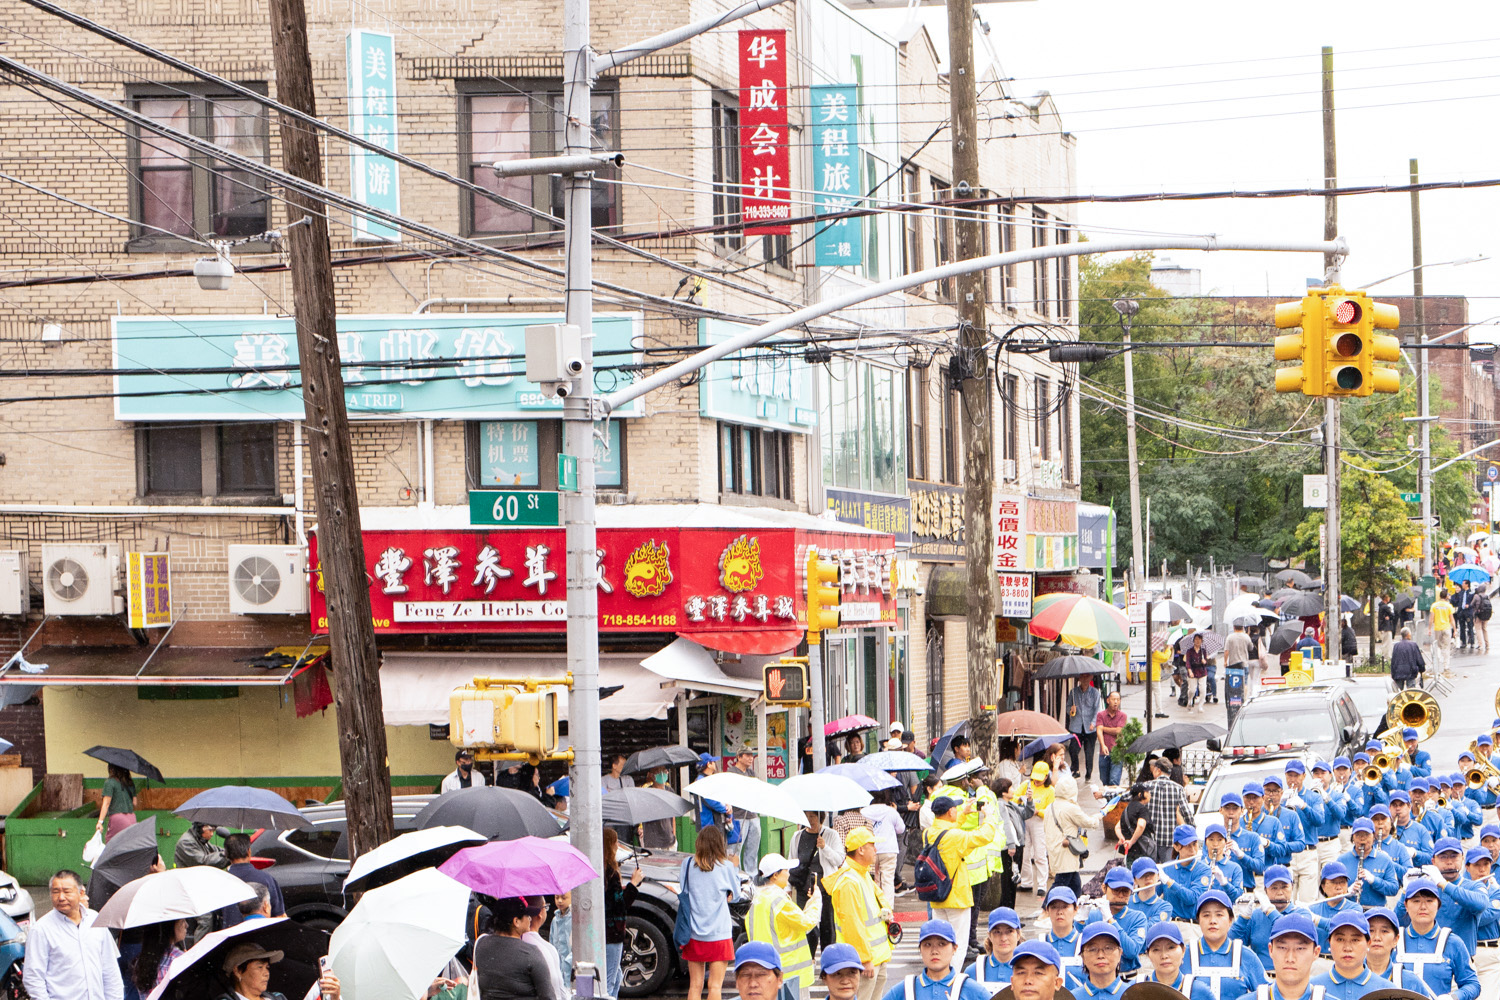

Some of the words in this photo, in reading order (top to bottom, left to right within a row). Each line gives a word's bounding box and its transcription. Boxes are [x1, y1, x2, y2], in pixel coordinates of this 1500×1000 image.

[747, 36, 781, 198] 华成会计
[820, 92, 852, 227] 美程旅游
[362, 393, 397, 406] TRIP
[492, 495, 519, 520] 60
[527, 495, 539, 509] St
[836, 500, 861, 519] GALAXY
[997, 501, 1019, 567] 高價收金
[374, 544, 614, 596] 豐澤参茸
[1001, 589, 1029, 598] 83-8800
[404, 604, 444, 620] Feng
[452, 604, 473, 617] Ze
[481, 603, 533, 617] Herbs
[602, 615, 677, 626] 718-854-1188
